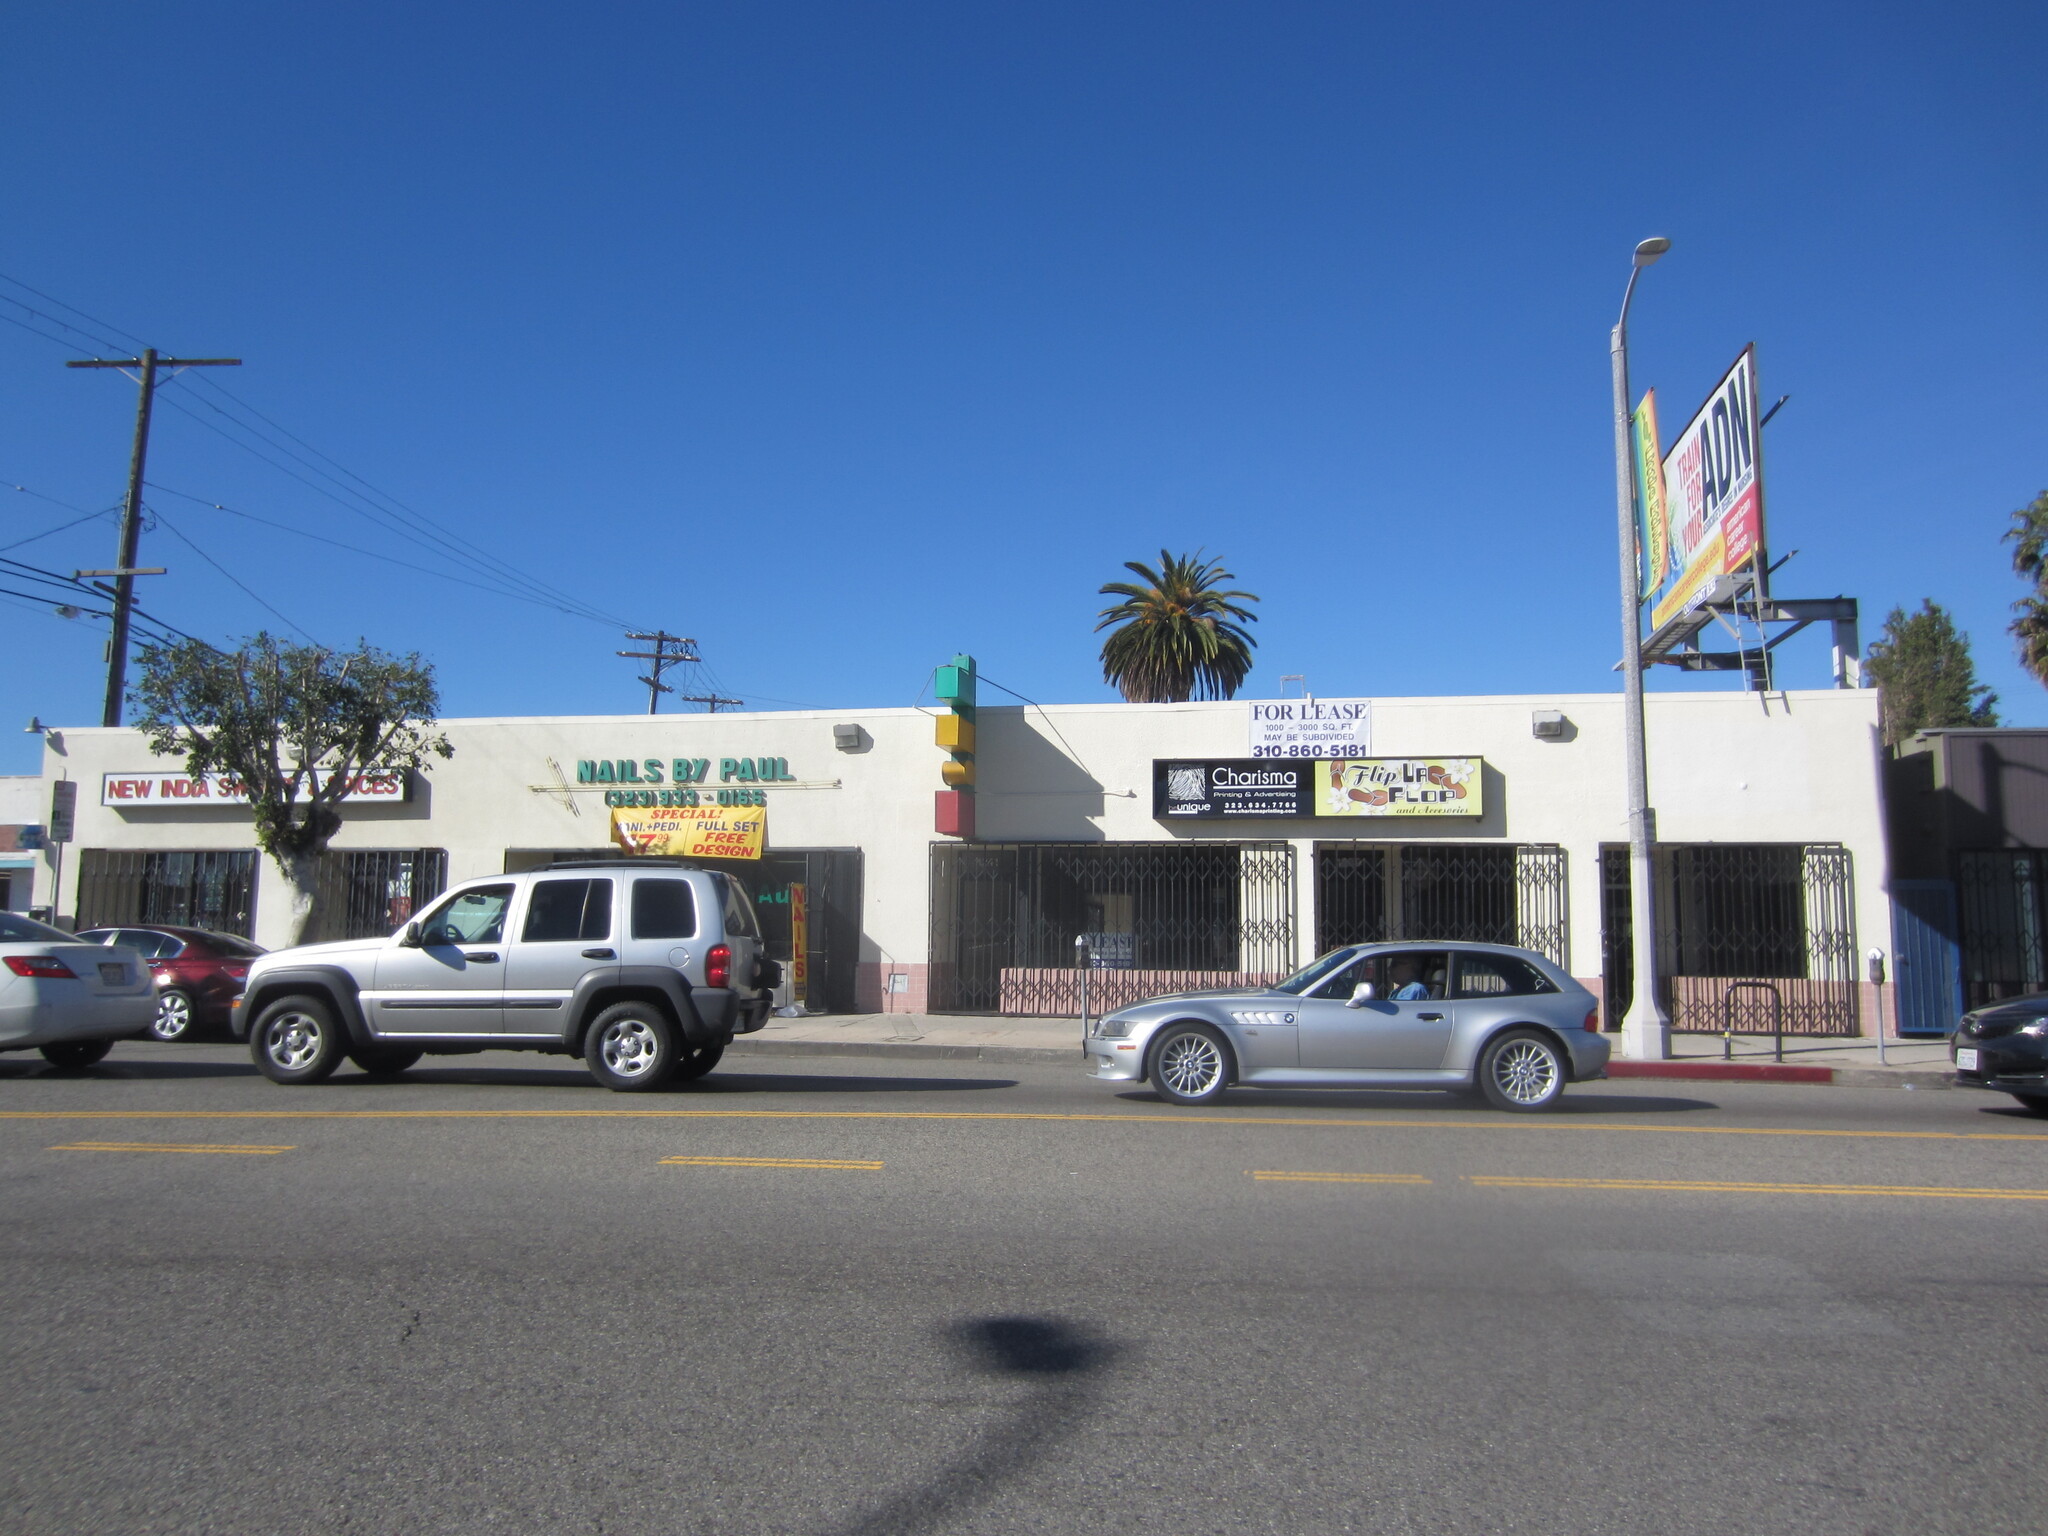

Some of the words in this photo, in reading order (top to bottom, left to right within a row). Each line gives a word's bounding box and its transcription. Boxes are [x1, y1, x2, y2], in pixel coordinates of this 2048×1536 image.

[1700, 364, 1751, 522] ADN
[1677, 432, 1701, 490] TRAIN
[1686, 471, 1702, 517] FOR
[1682, 508, 1703, 558] YOUR
[1253, 704, 1294, 720] FOR
[1301, 703, 1368, 720] LEASE
[1322, 723, 1338, 731] SQ.
[1341, 723, 1354, 731] FT.
[1302, 733, 1355, 741] SUBDIVIDED
[1253, 744, 1367, 757] 310-860-5181
[577, 759, 662, 783] NAILS
[672, 758, 709, 782] BY
[720, 757, 795, 782] PAUL
[1212, 767, 1297, 785] Charisma
[1346, 765, 1397, 786] Flip
[108, 779, 153, 799] NEW
[1389, 787, 1455, 803] FLOP
[651, 809, 723, 820] SPECIAL!
[1396, 806, 1416, 814] and
[696, 821, 728, 831] FULL
[733, 821, 759, 832] SET
[705, 832, 748, 844] FREE
[692, 844, 755, 857] DESIGN
[793, 887, 805, 978] NAILS
